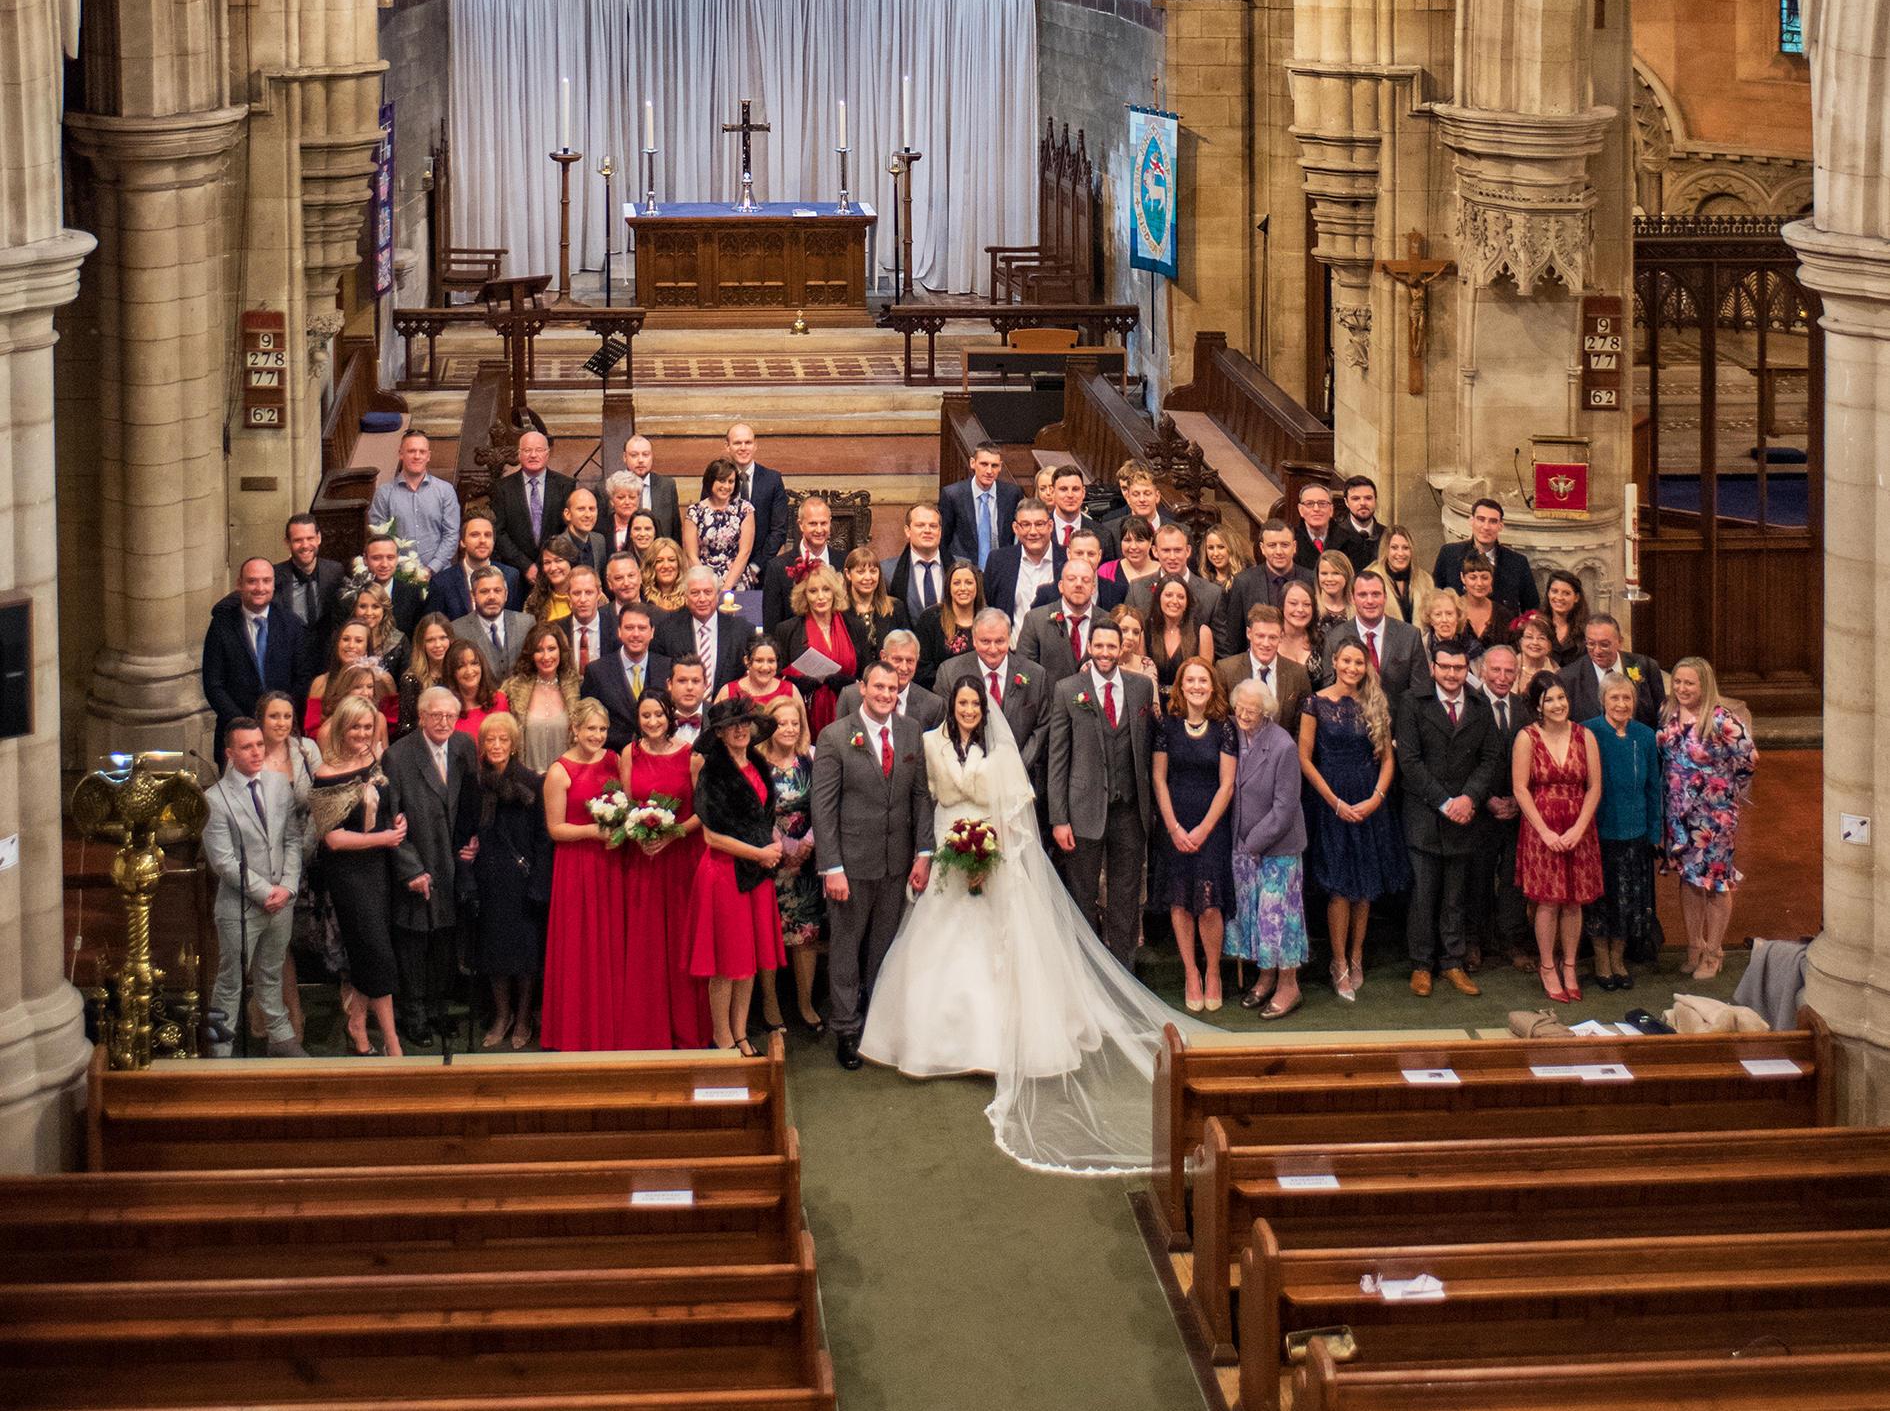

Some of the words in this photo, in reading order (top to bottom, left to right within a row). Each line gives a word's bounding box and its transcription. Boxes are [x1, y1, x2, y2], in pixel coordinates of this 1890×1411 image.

[1598, 318, 1608, 332] 9
[261, 334, 272, 348] 9
[1586, 336, 1620, 350] 278
[250, 352, 285, 366] 278
[1592, 354, 1614, 368] 77
[254, 371, 276, 385] 77
[1592, 390, 1614, 404] 62
[252, 408, 276, 422] 62
